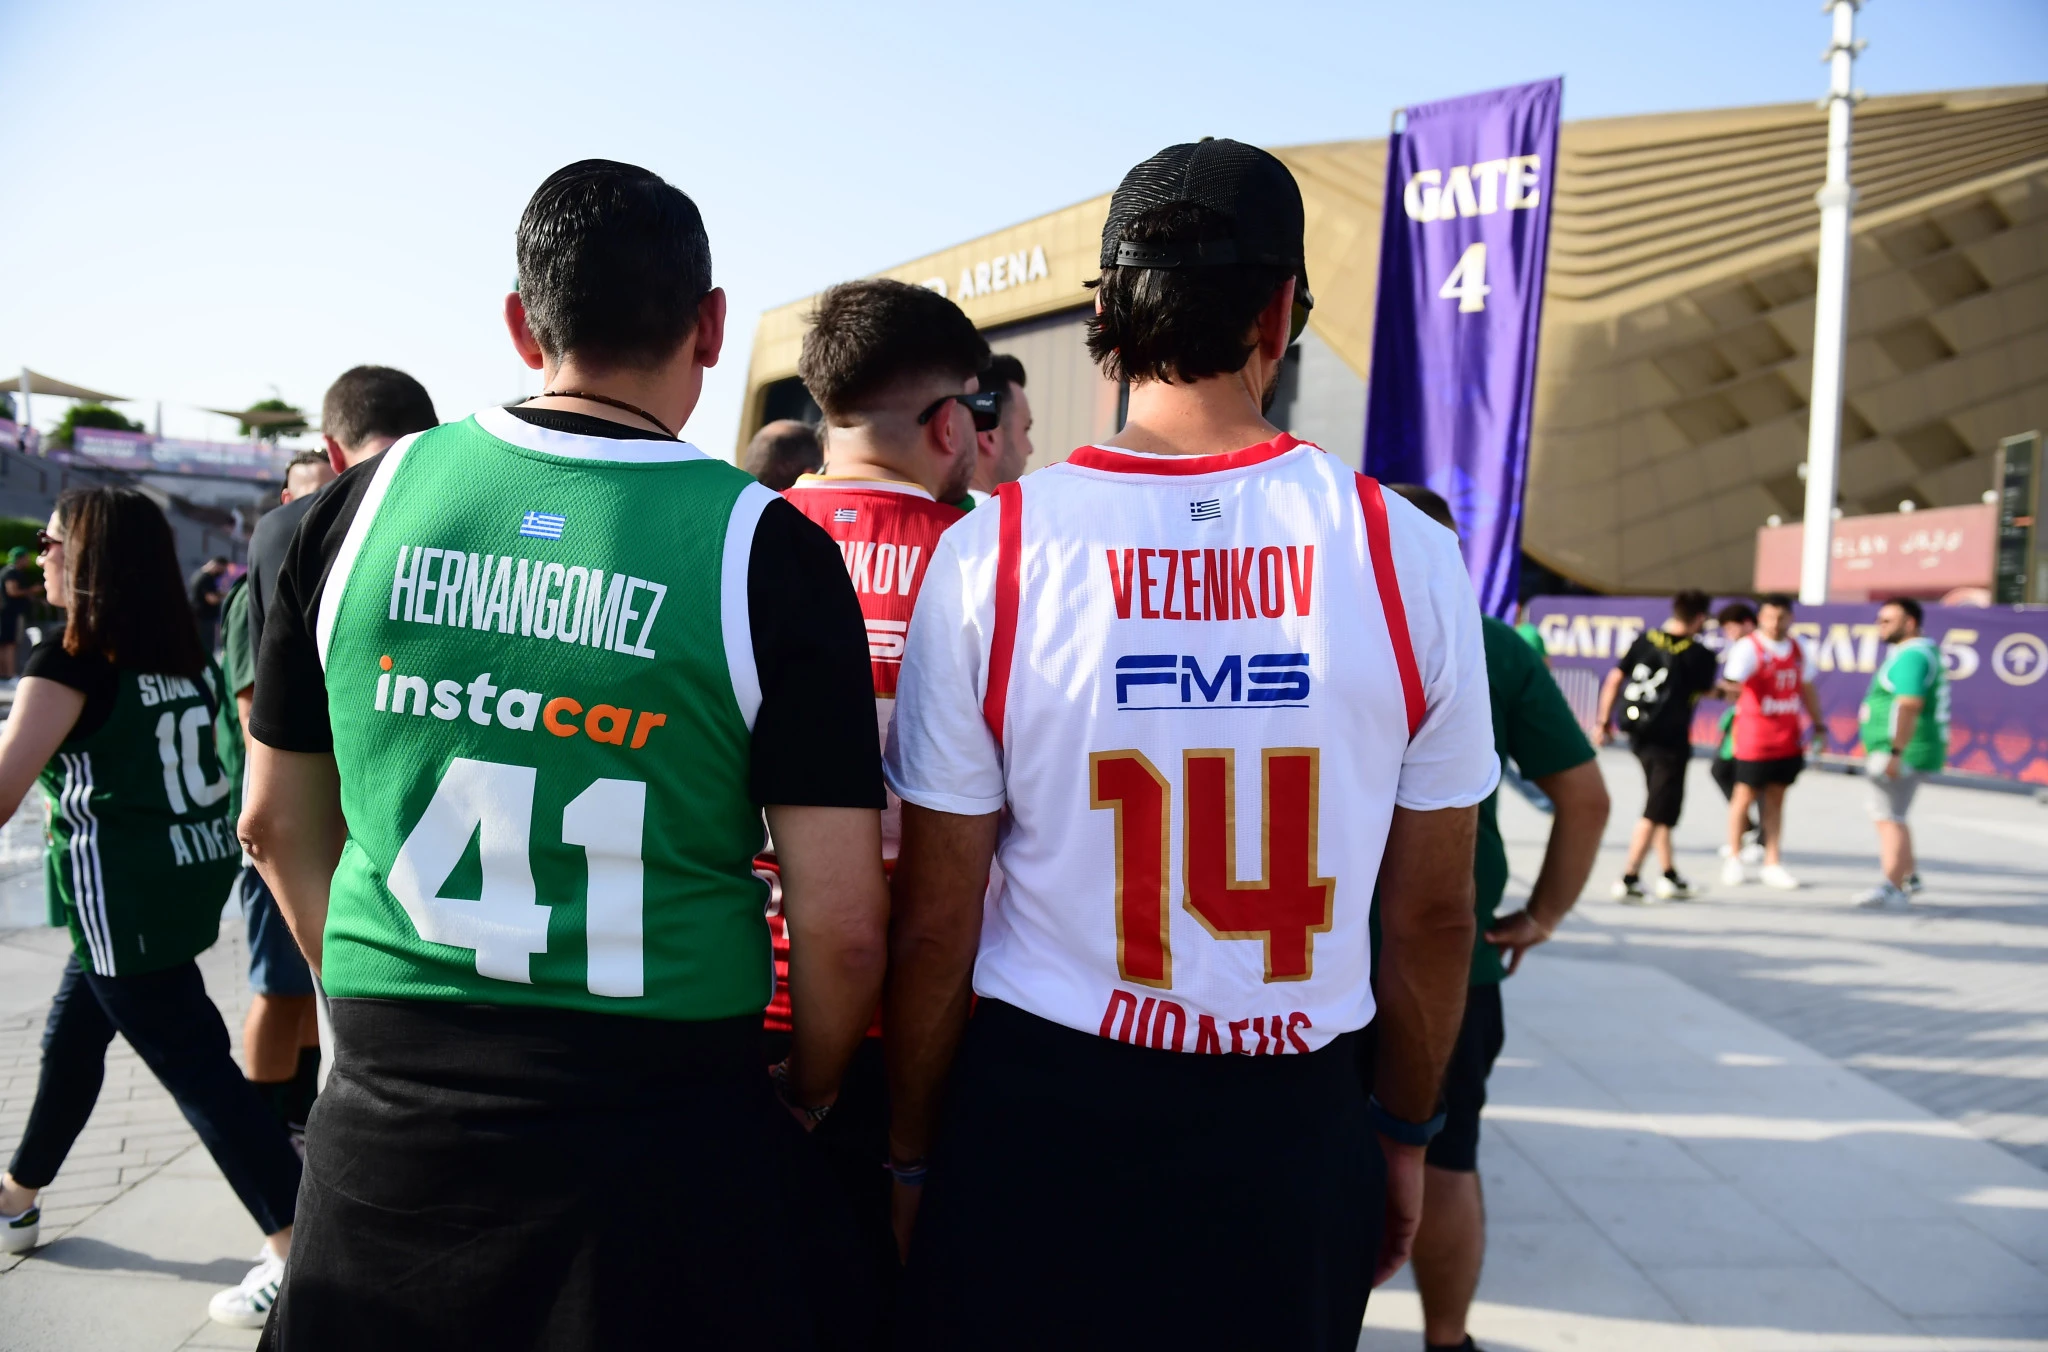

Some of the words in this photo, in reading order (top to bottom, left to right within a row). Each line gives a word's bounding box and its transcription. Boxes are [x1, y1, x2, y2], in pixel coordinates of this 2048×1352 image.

[1404, 154, 1540, 223] GATE
[957, 245, 1049, 301] ARENA
[1438, 242, 1492, 313] 4
[389, 545, 667, 659] HERNANGOMEZ
[1106, 545, 1314, 621] VEZENKOV
[374, 655, 667, 749] instacar
[1116, 653, 1310, 704] FMS
[155, 705, 230, 815] 10
[387, 757, 646, 997] 41
[1089, 747, 1336, 990] 14
